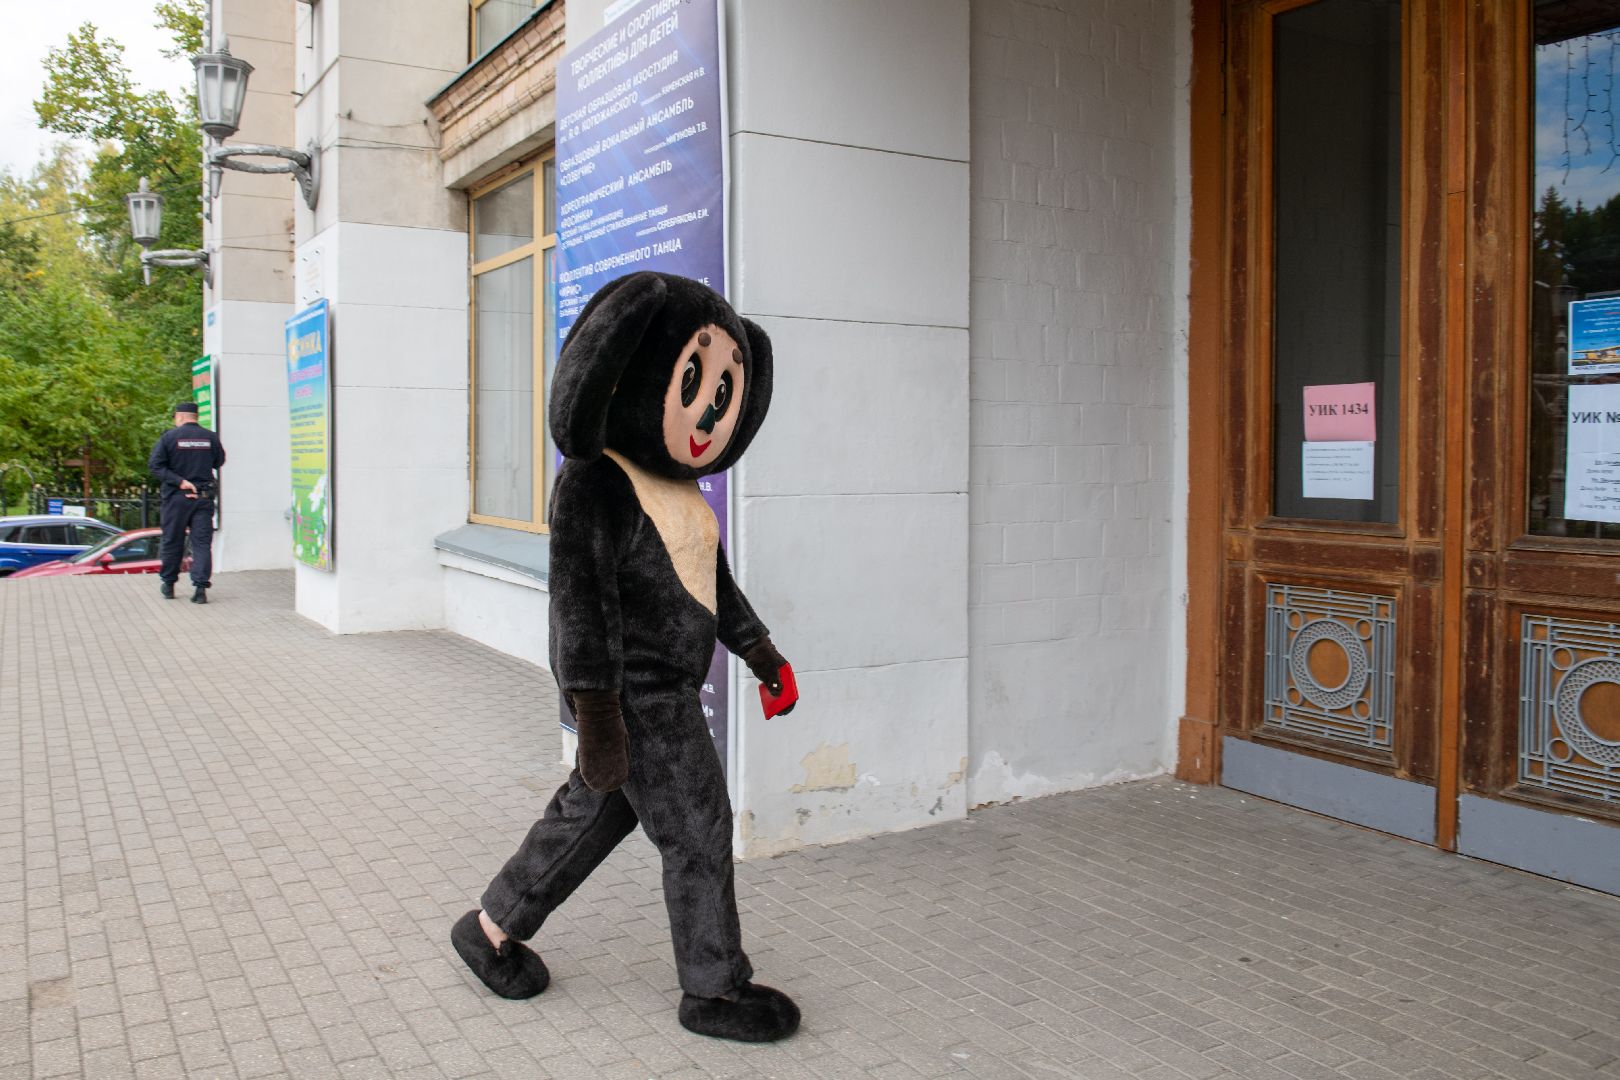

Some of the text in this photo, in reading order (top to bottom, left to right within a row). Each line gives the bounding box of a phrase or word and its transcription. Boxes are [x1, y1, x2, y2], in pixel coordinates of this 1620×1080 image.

[619, 27, 626, 43] И
[627, 0, 682, 37] СПОРТИВН
[577, 10, 679, 93] КОЛЛЕКТИВЫ ДЛЯ ДЕТЕЙ
[560, 49, 679, 131] ДЕТСКАЯ ОБРАЗЦОВАЯ ИЗОСТУДИЯ
[601, 117, 645, 152] ВОКАЛЬНЫЙ
[646, 96, 695, 129] АНСАМБЛЬ
[696, 121, 708, 134] Т.В.
[628, 159, 673, 187] АНСАМБЛЬ
[559, 237, 683, 284] КОЛЛЕКТИВ СОВРЕМЕННОГО ТАНЦА
[1309, 403, 1369, 416] УИК 1434
[1572, 411, 1602, 423] УИК
